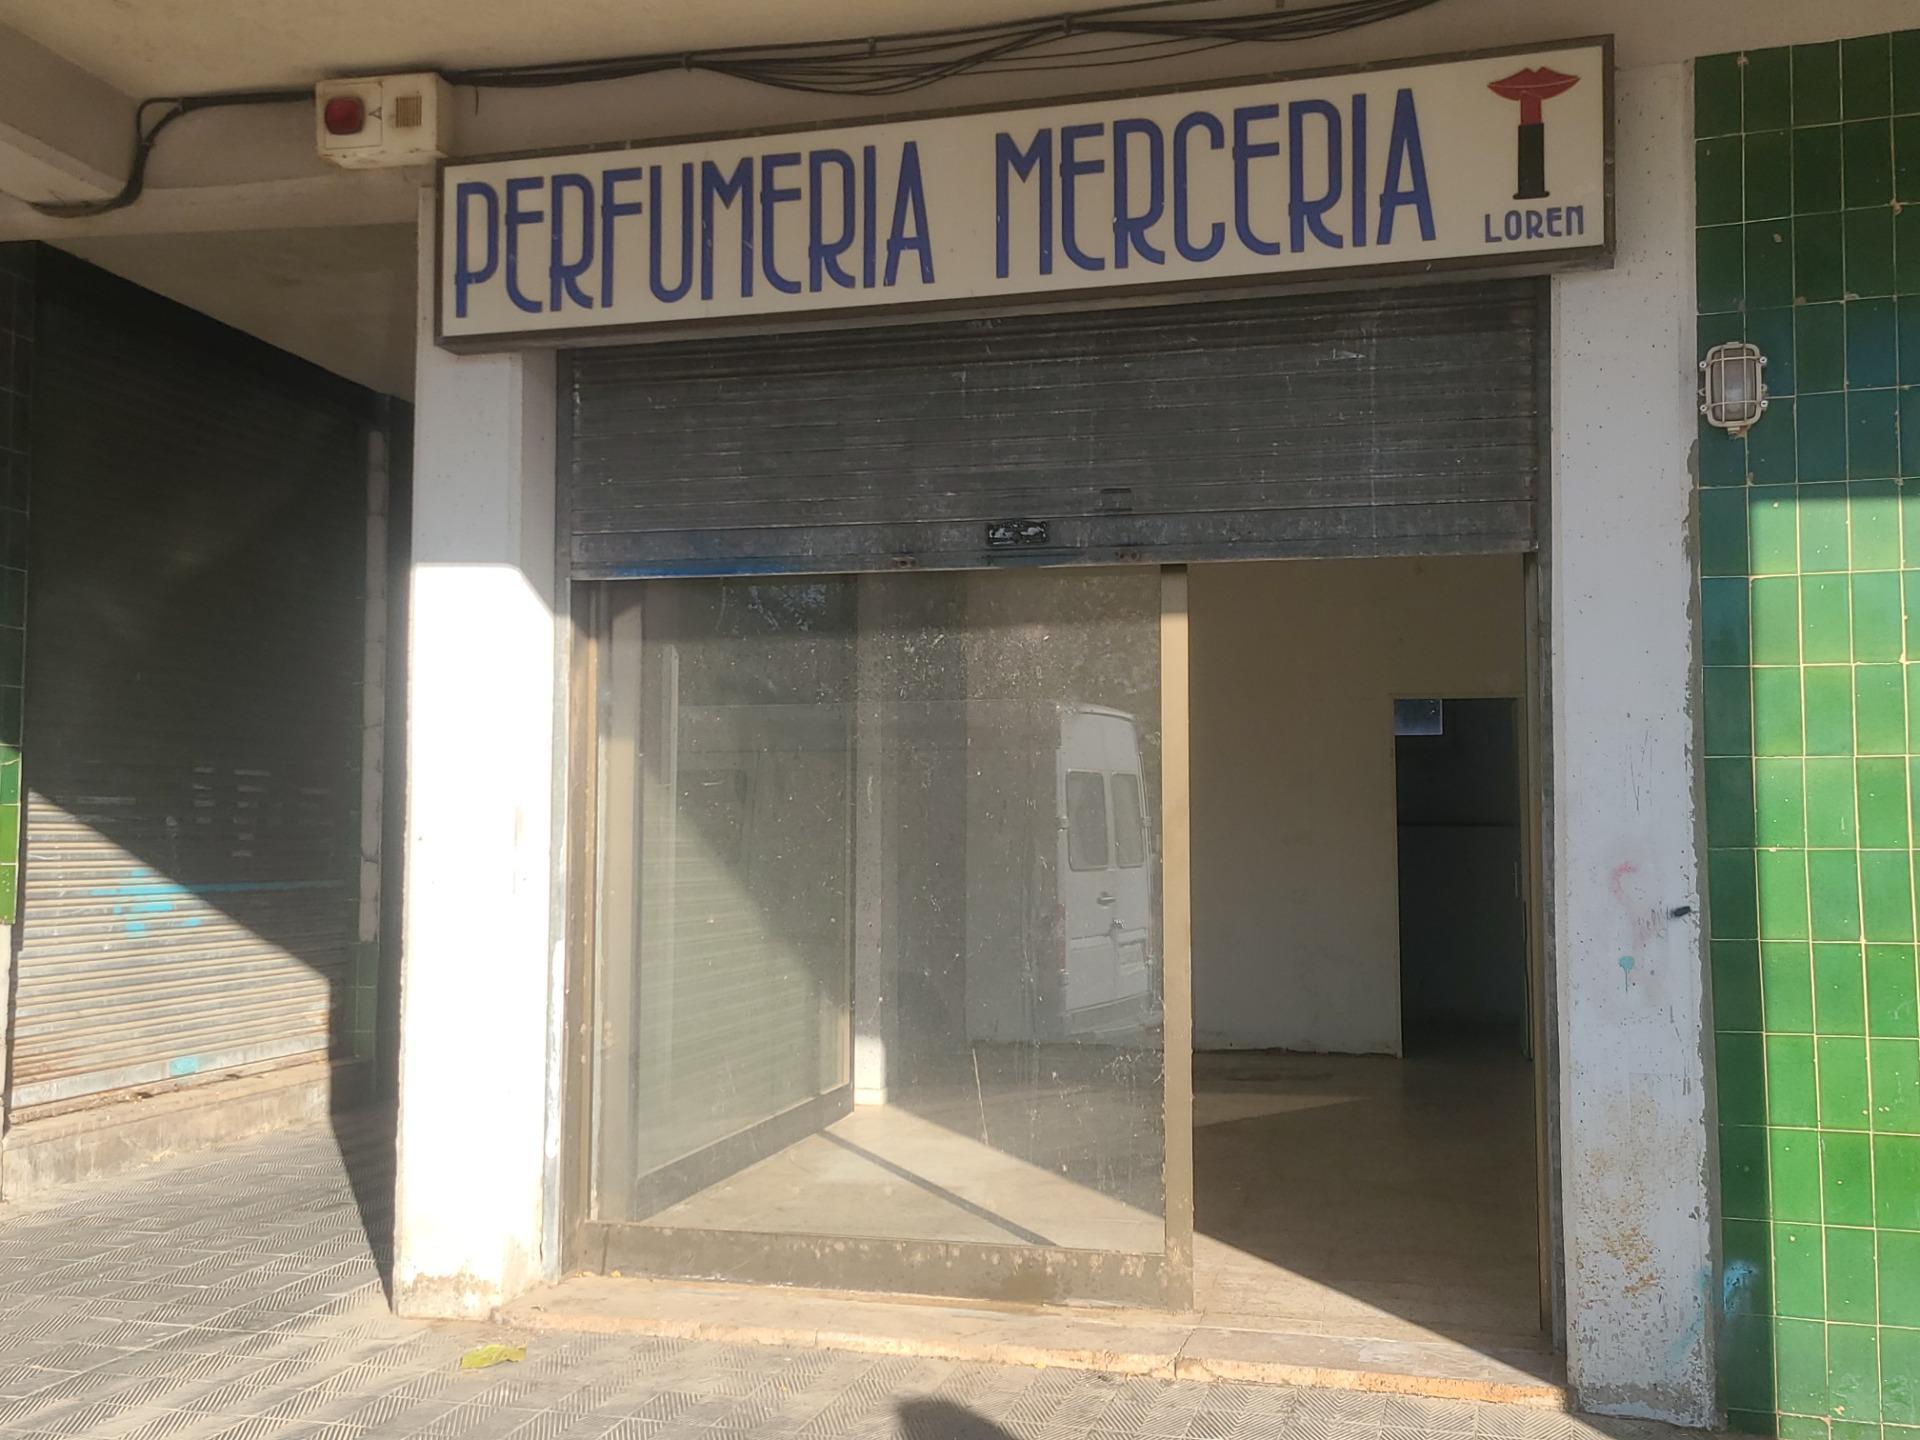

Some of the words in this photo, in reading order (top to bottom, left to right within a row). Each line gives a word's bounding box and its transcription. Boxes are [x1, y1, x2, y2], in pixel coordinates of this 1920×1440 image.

[455, 141, 935, 318] PERFUMERIA
[995, 87, 1436, 279] MERCERIA
[1484, 204, 1584, 243] LOREN
